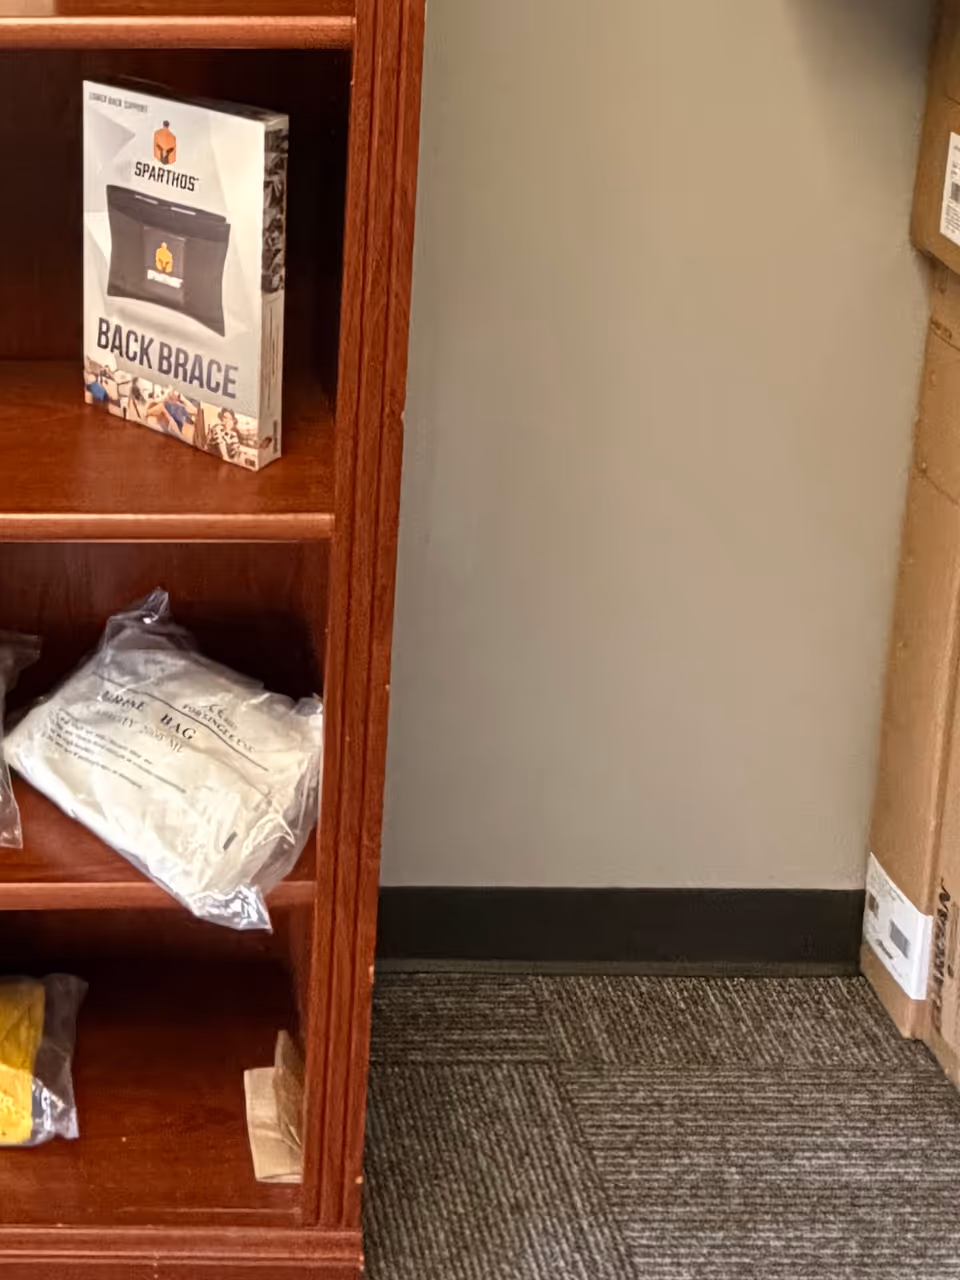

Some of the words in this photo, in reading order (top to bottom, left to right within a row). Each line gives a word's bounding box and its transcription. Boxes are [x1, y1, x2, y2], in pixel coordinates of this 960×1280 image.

[135, 161, 195, 192] SPARTHOS
[97, 317, 154, 369] BACK
[158, 341, 239, 399] BRACE
[159, 713, 197, 740] BAG
